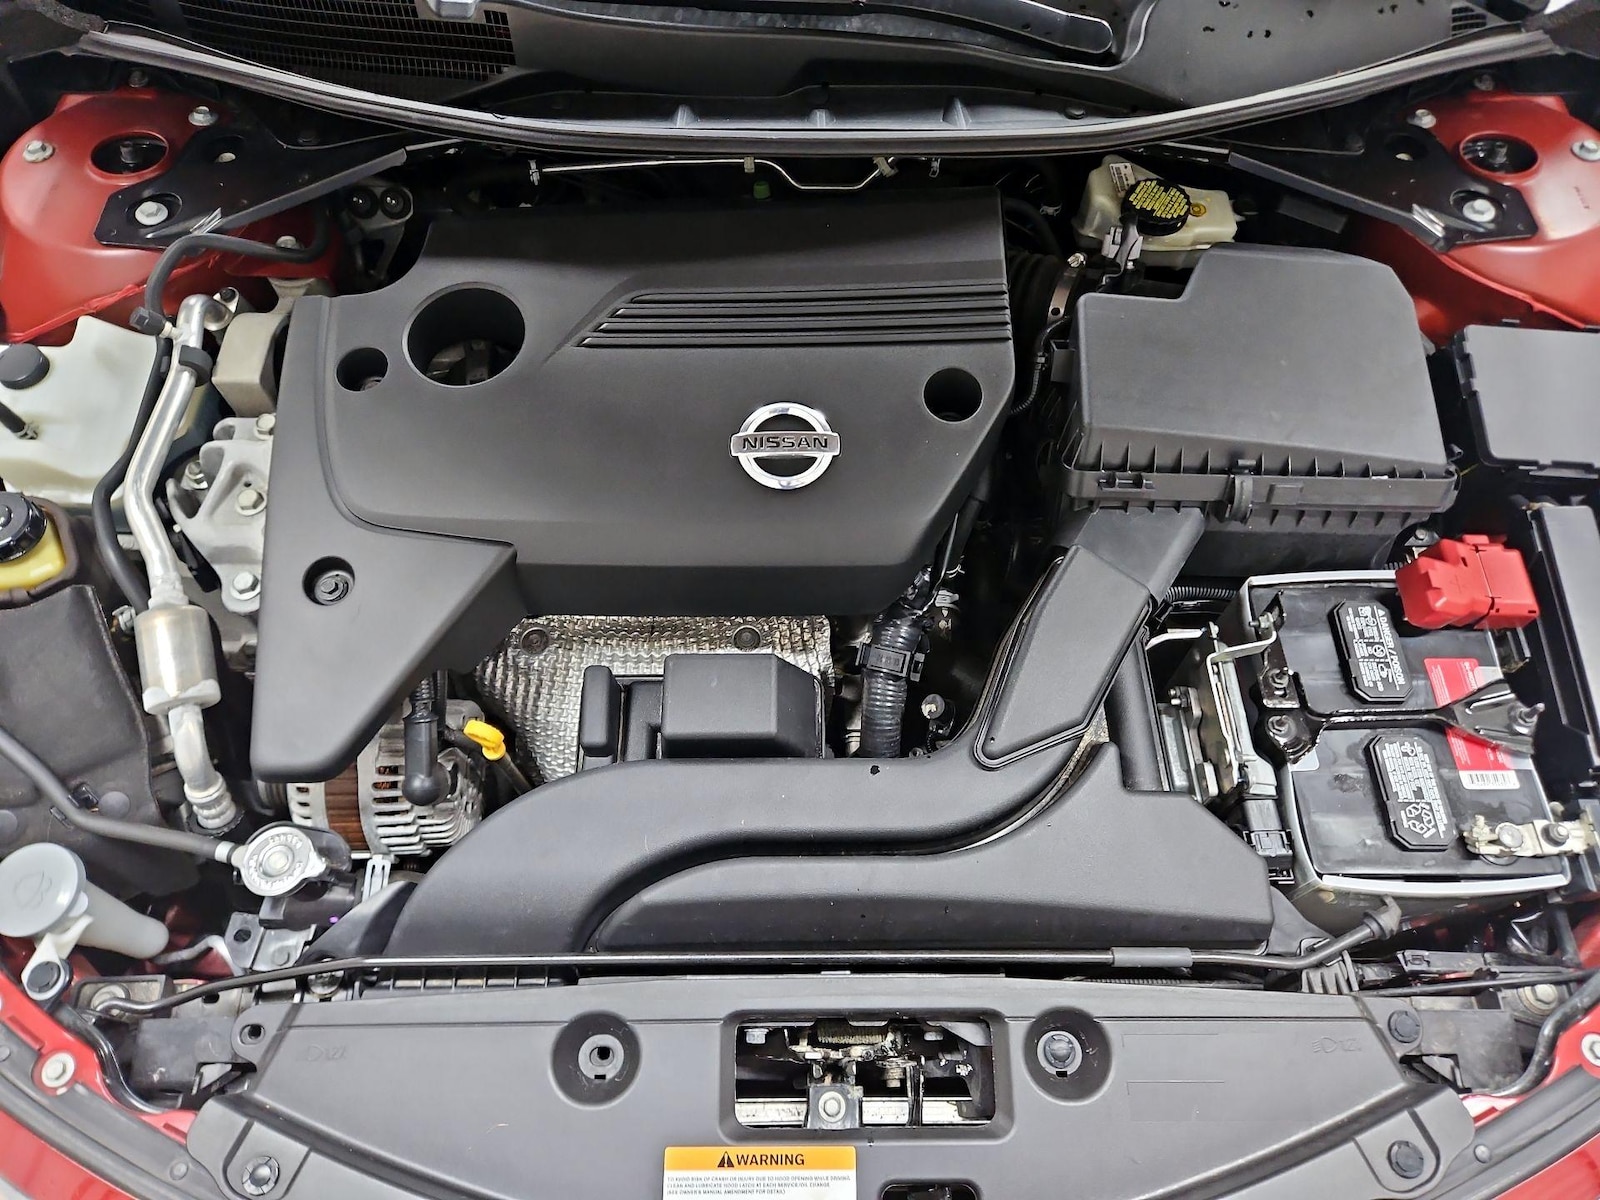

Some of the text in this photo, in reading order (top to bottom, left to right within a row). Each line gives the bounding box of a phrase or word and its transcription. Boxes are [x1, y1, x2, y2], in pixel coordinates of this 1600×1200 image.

[742, 436, 828, 450] NISSAN
[1380, 616, 1395, 648] DANGER
[1390, 655, 1406, 684] POISON
[736, 1153, 805, 1166] WARNING
